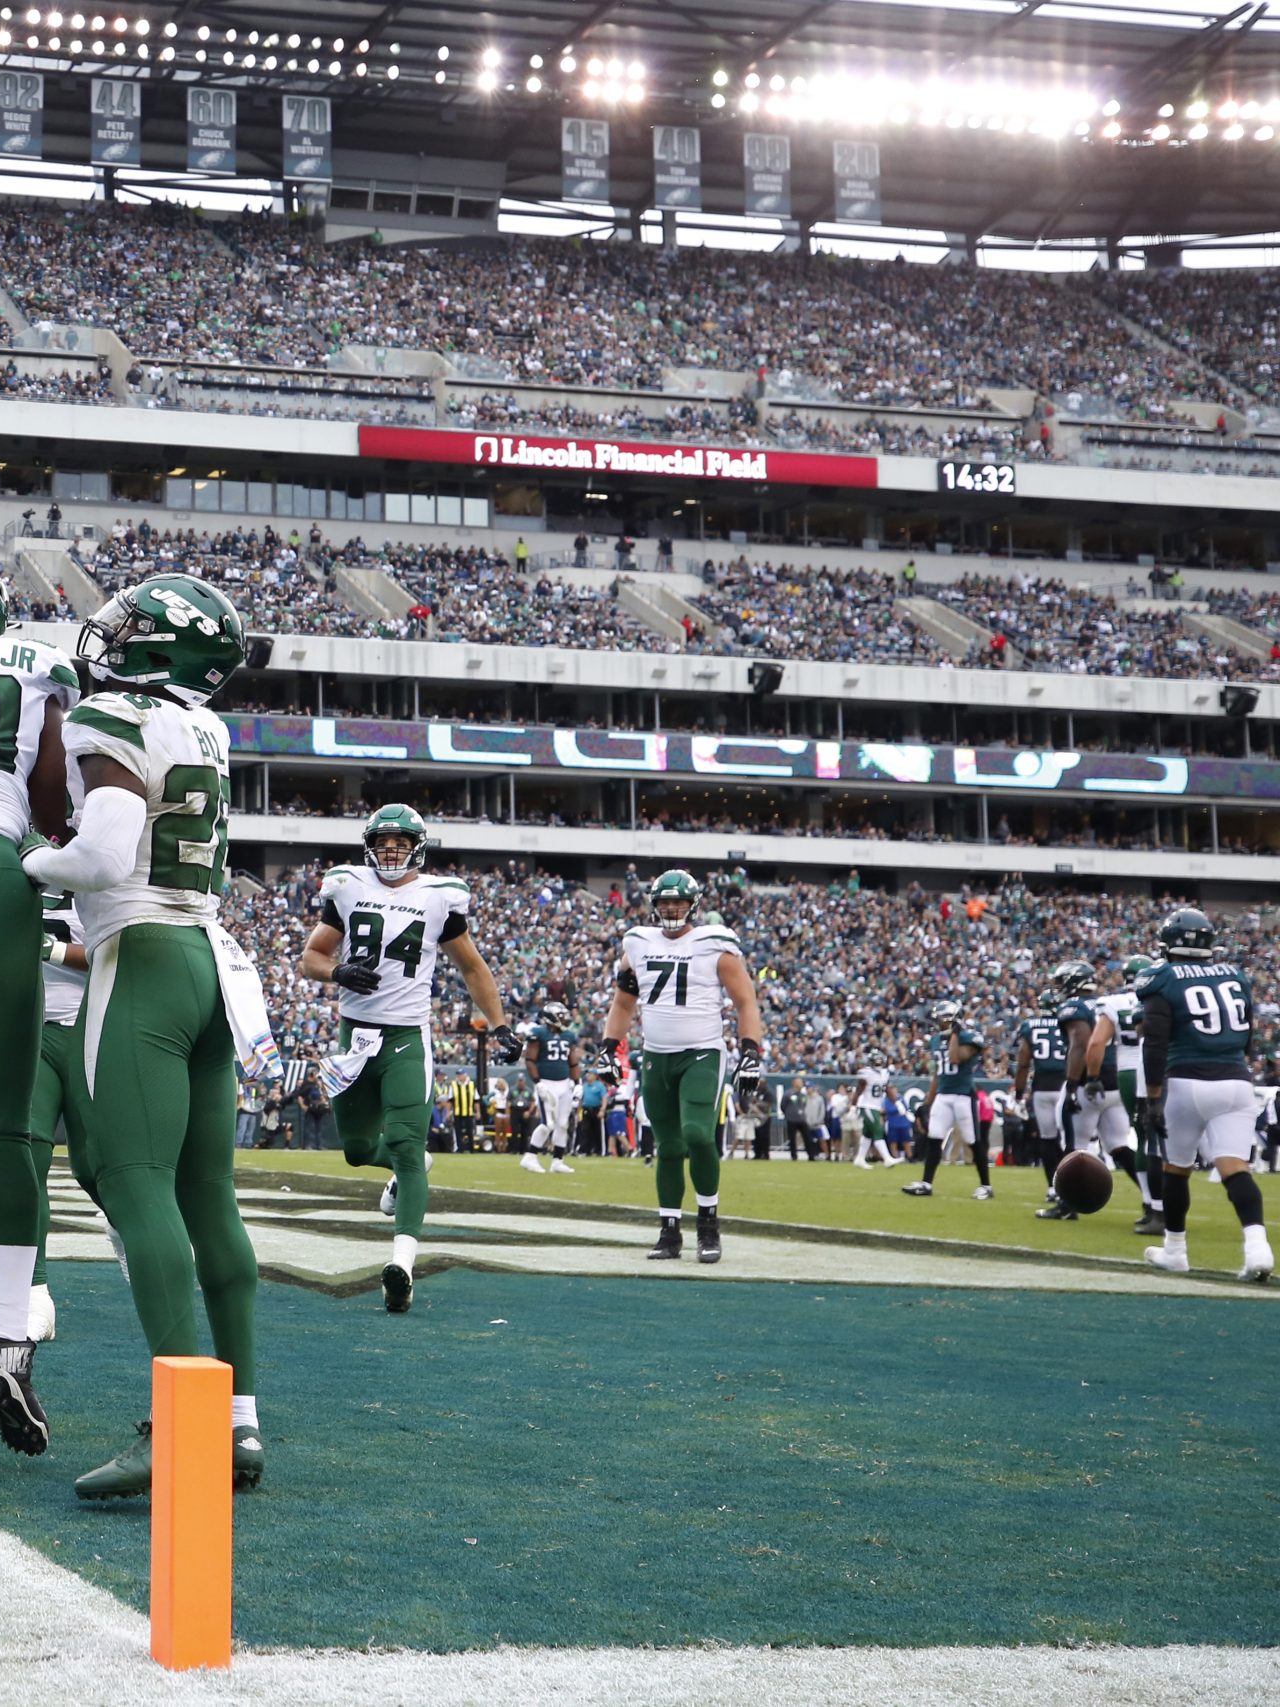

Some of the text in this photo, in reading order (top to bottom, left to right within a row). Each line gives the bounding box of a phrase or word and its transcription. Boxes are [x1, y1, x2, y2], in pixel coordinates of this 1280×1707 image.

[95, 81, 136, 119] 44
[191, 90, 232, 128] 60
[287, 97, 328, 134] 70
[4, 121, 30, 132] WHITE
[106, 121, 125, 132] PETE
[302, 137, 312, 146] AL
[566, 121, 605, 158] 15
[658, 127, 696, 164] 40
[501, 438, 767, 479] Lincoln Financial Field
[942, 463, 1014, 493] 14:32
[150, 588, 220, 636] JETS
[0, 644, 37, 674] JR
[355, 901, 426, 917] NEW YORK
[348, 911, 426, 979] 84
[646, 961, 689, 1006] 71
[1184, 980, 1251, 1035] 96
[547, 1040, 570, 1061] 55
[1032, 1028, 1066, 1060] 53
